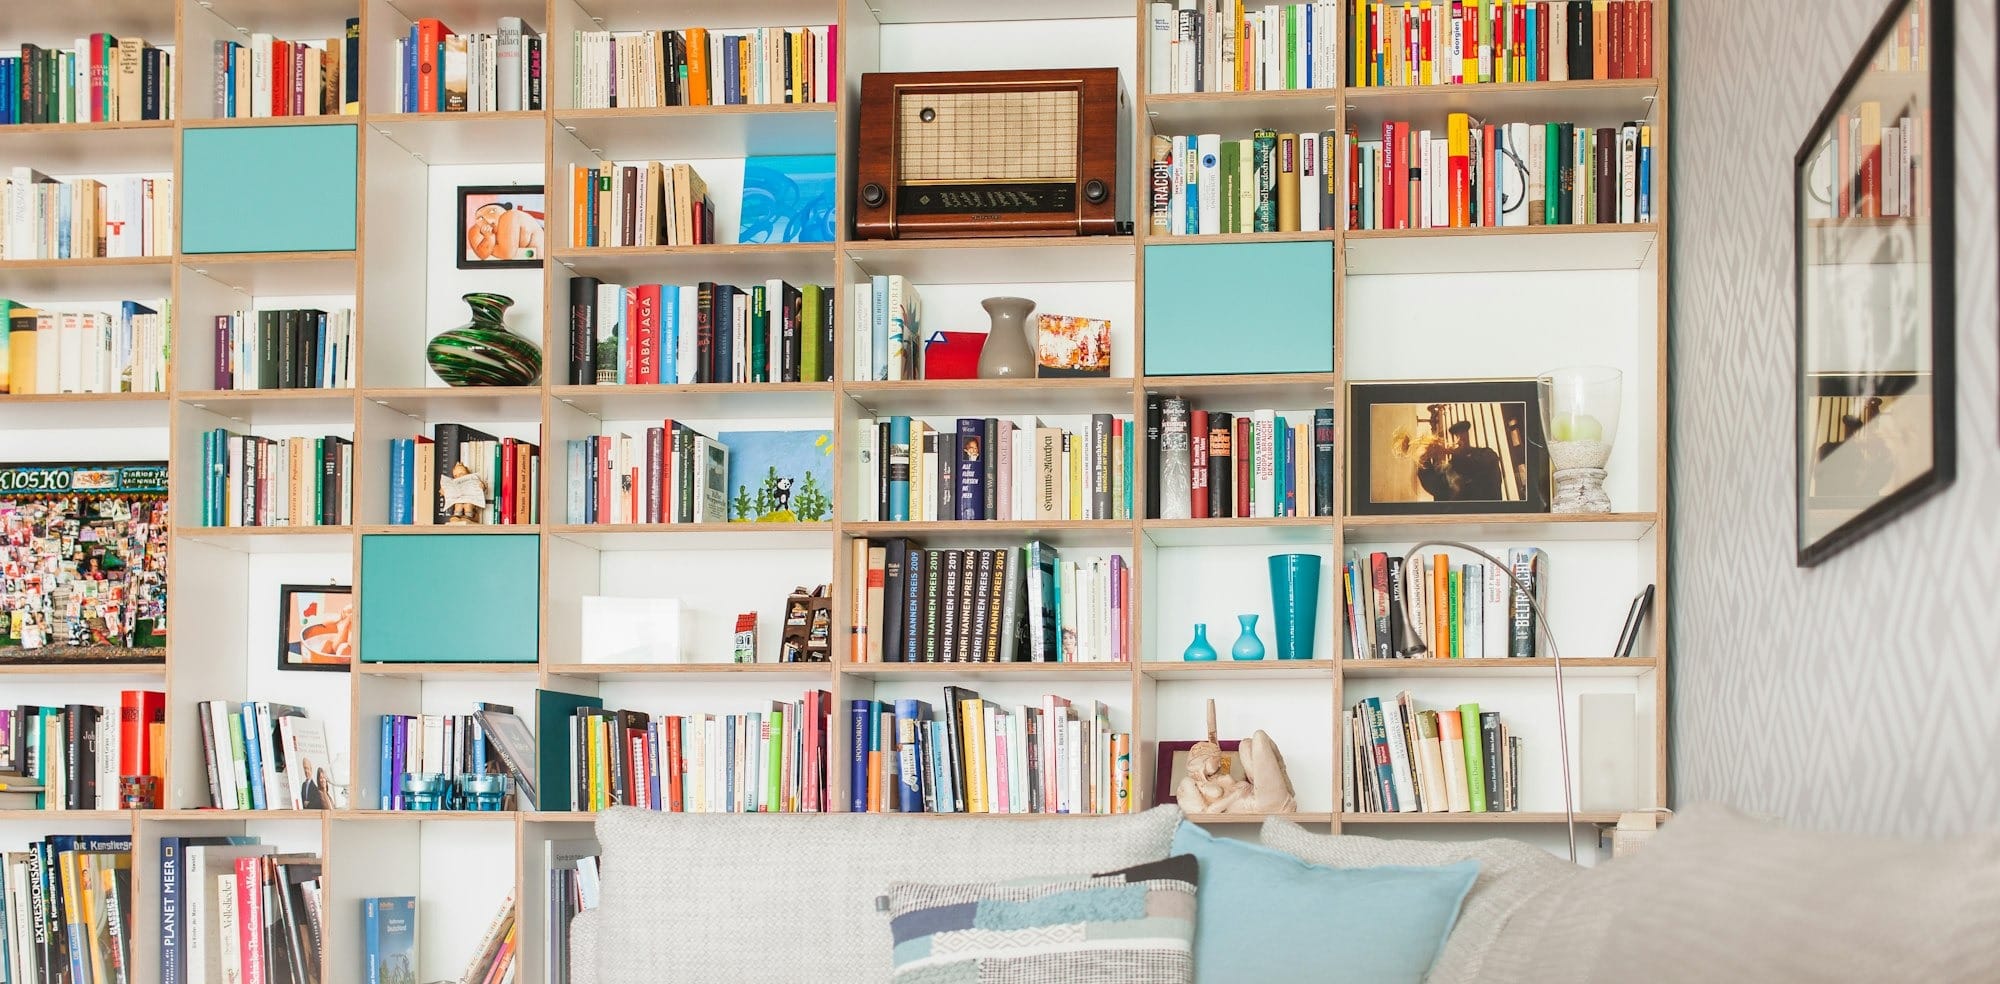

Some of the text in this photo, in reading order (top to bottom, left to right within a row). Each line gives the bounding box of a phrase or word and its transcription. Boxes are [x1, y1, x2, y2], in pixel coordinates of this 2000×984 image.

[1453, 21, 1462, 55] Georgien
[216, 55, 225, 104] NABOKOV
[1384, 124, 1393, 168] Fundraising
[1153, 161, 1169, 226] BELTRACCHI
[1261, 163, 1270, 181] doch
[1261, 181, 1270, 193] hat
[1624, 153, 1635, 198] MEXICO
[1261, 194, 1270, 211] Bibel
[1261, 211, 1270, 222] die
[891, 281, 899, 333] EUPHORIA
[641, 297, 651, 375] BABA JAGA
[1043, 435, 1053, 511] Grimms Märchen
[1095, 420, 1104, 493] Heinz Buschkowsky
[1192, 468, 1200, 489] Michael
[911, 552, 919, 571] 2009
[930, 551, 938, 570] 2010
[929, 572, 937, 597] PREIS
[944, 552, 957, 663] HENRI NANNEN PREIS 2011
[960, 551, 974, 662] HENRI NANNEN PREIS 2014
[973, 551, 990, 663] HENRI NANNEN PREIS 2013
[988, 551, 1005, 663] HENRI NANNEN PREIS 2012
[928, 599, 936, 635] NANNEN
[855, 716, 863, 762] SPONSORING
[30, 847, 44, 944] EXPRESSIONISMUS
[106, 898, 117, 936] CLASSICS
[163, 859, 175, 946] PLANET MEER
[222, 880, 233, 929] Volkslieder
